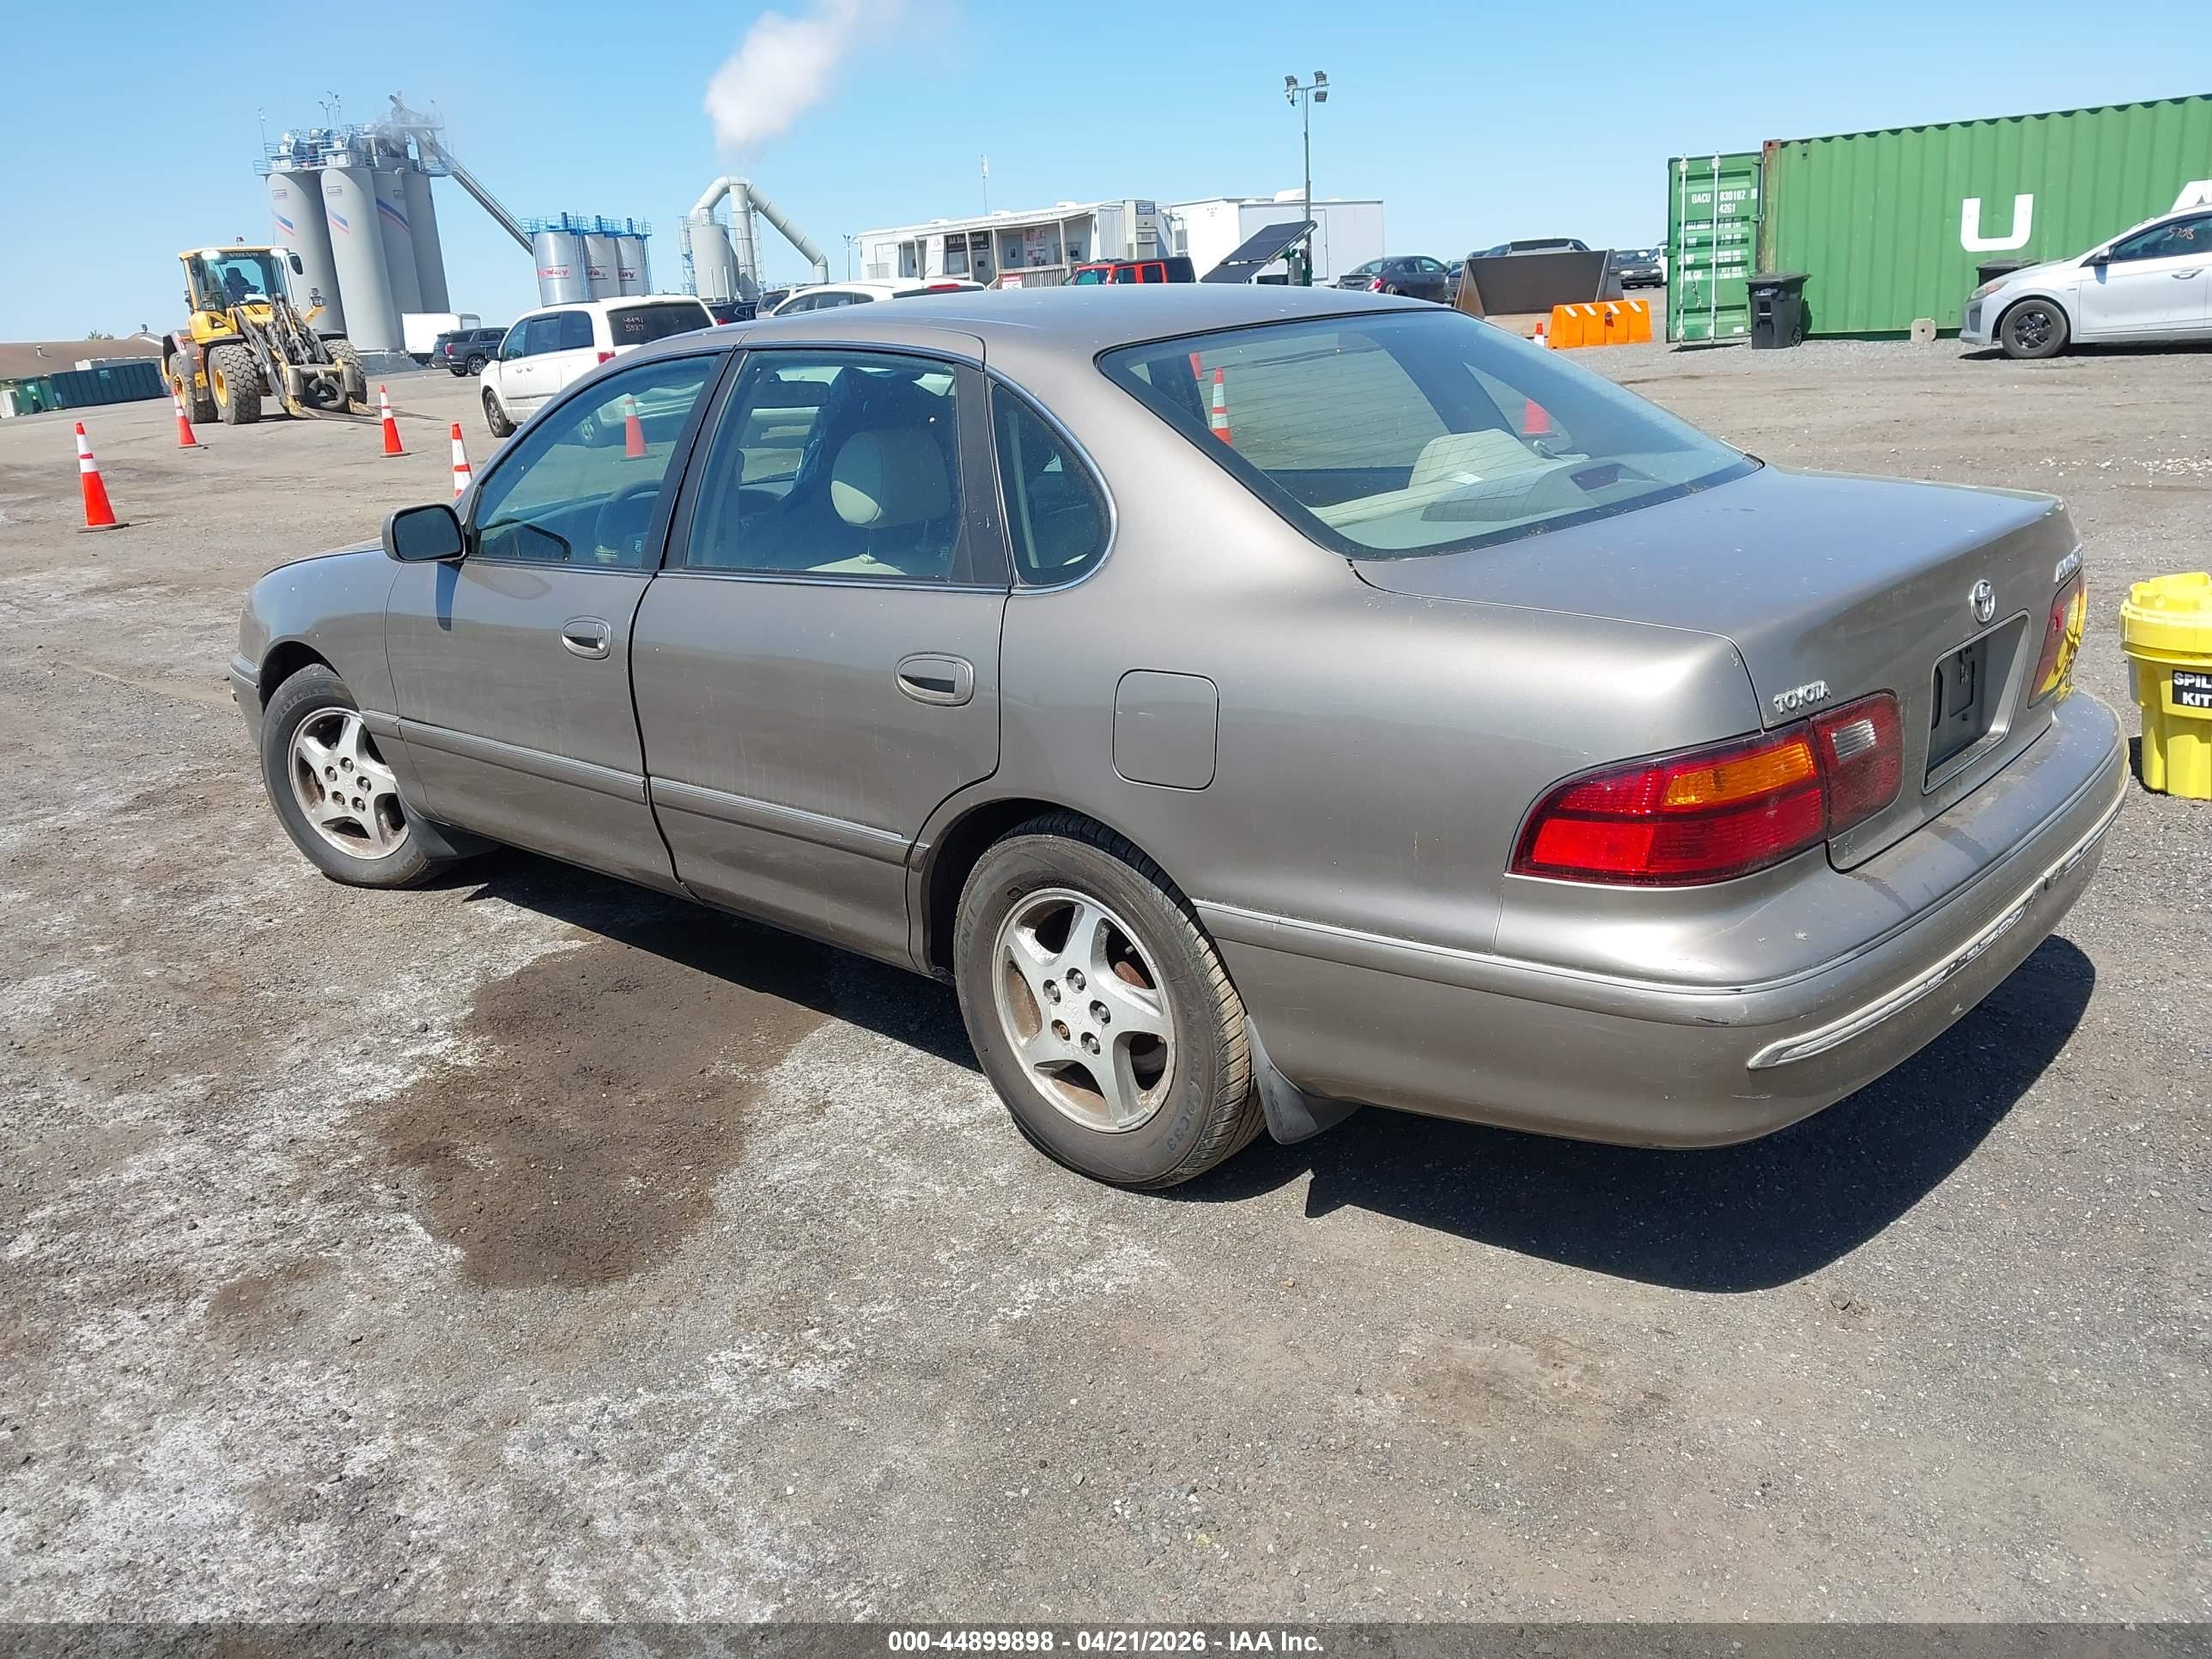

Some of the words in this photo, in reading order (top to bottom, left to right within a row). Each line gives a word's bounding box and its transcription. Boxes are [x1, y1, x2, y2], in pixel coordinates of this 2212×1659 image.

[2173, 672, 2212, 689] SPIL
[1772, 680, 1832, 714] TOYOTA
[2182, 691, 2212, 707] KIT
